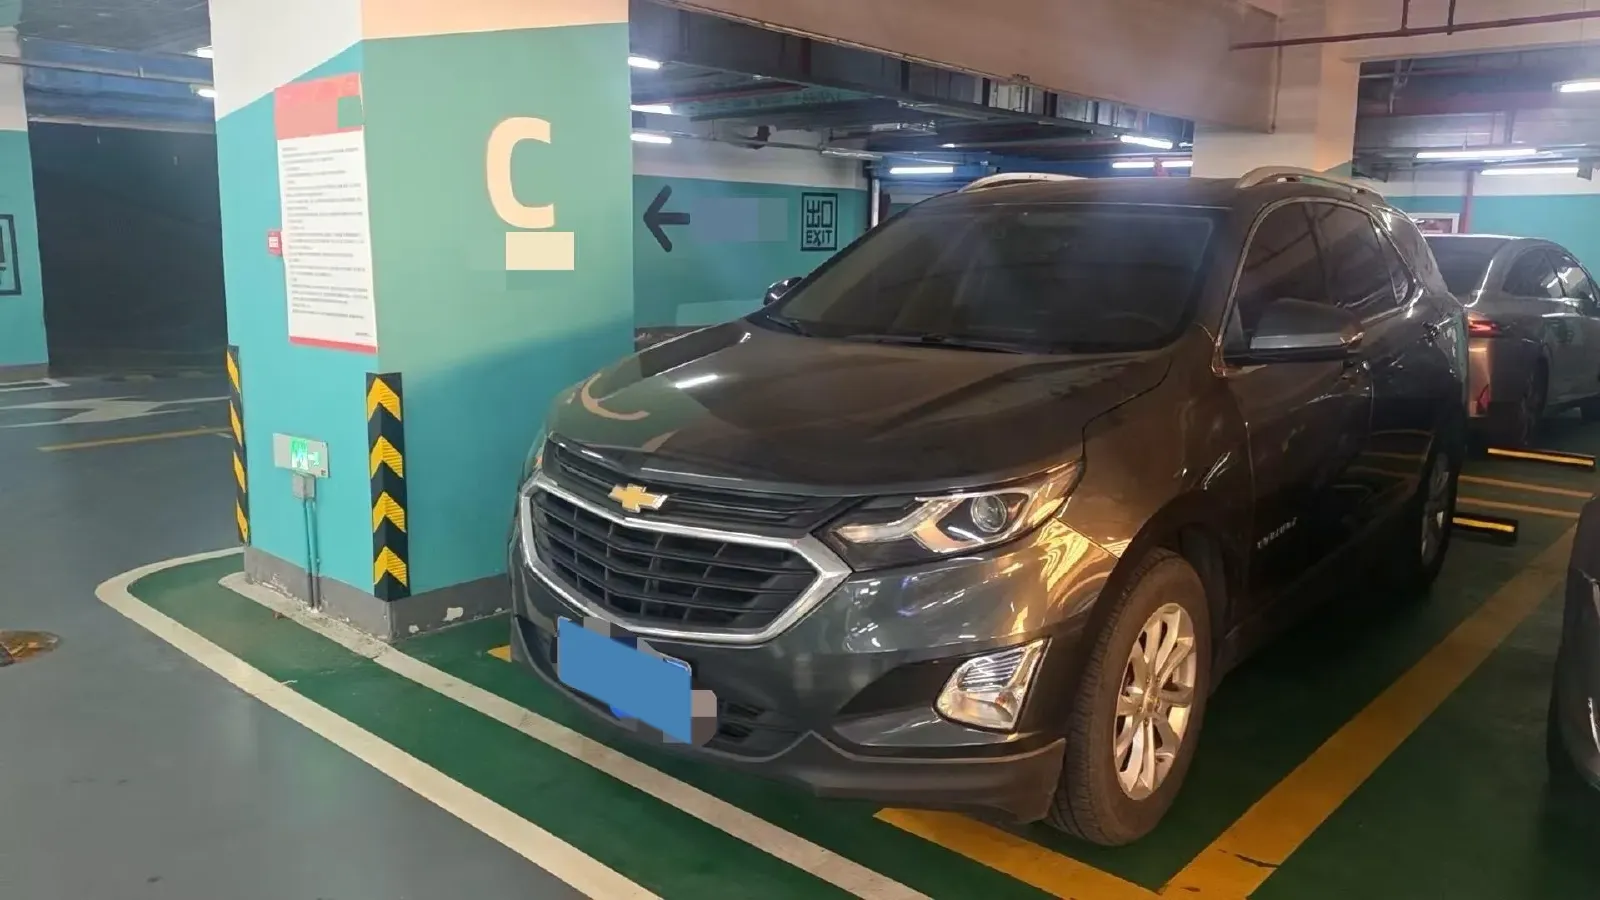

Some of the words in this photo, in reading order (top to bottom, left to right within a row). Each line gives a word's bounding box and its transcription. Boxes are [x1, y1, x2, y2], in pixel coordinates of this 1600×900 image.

[486, 116, 555, 229] C
[806, 200, 833, 228] 出口
[806, 229, 833, 246] EXIT
